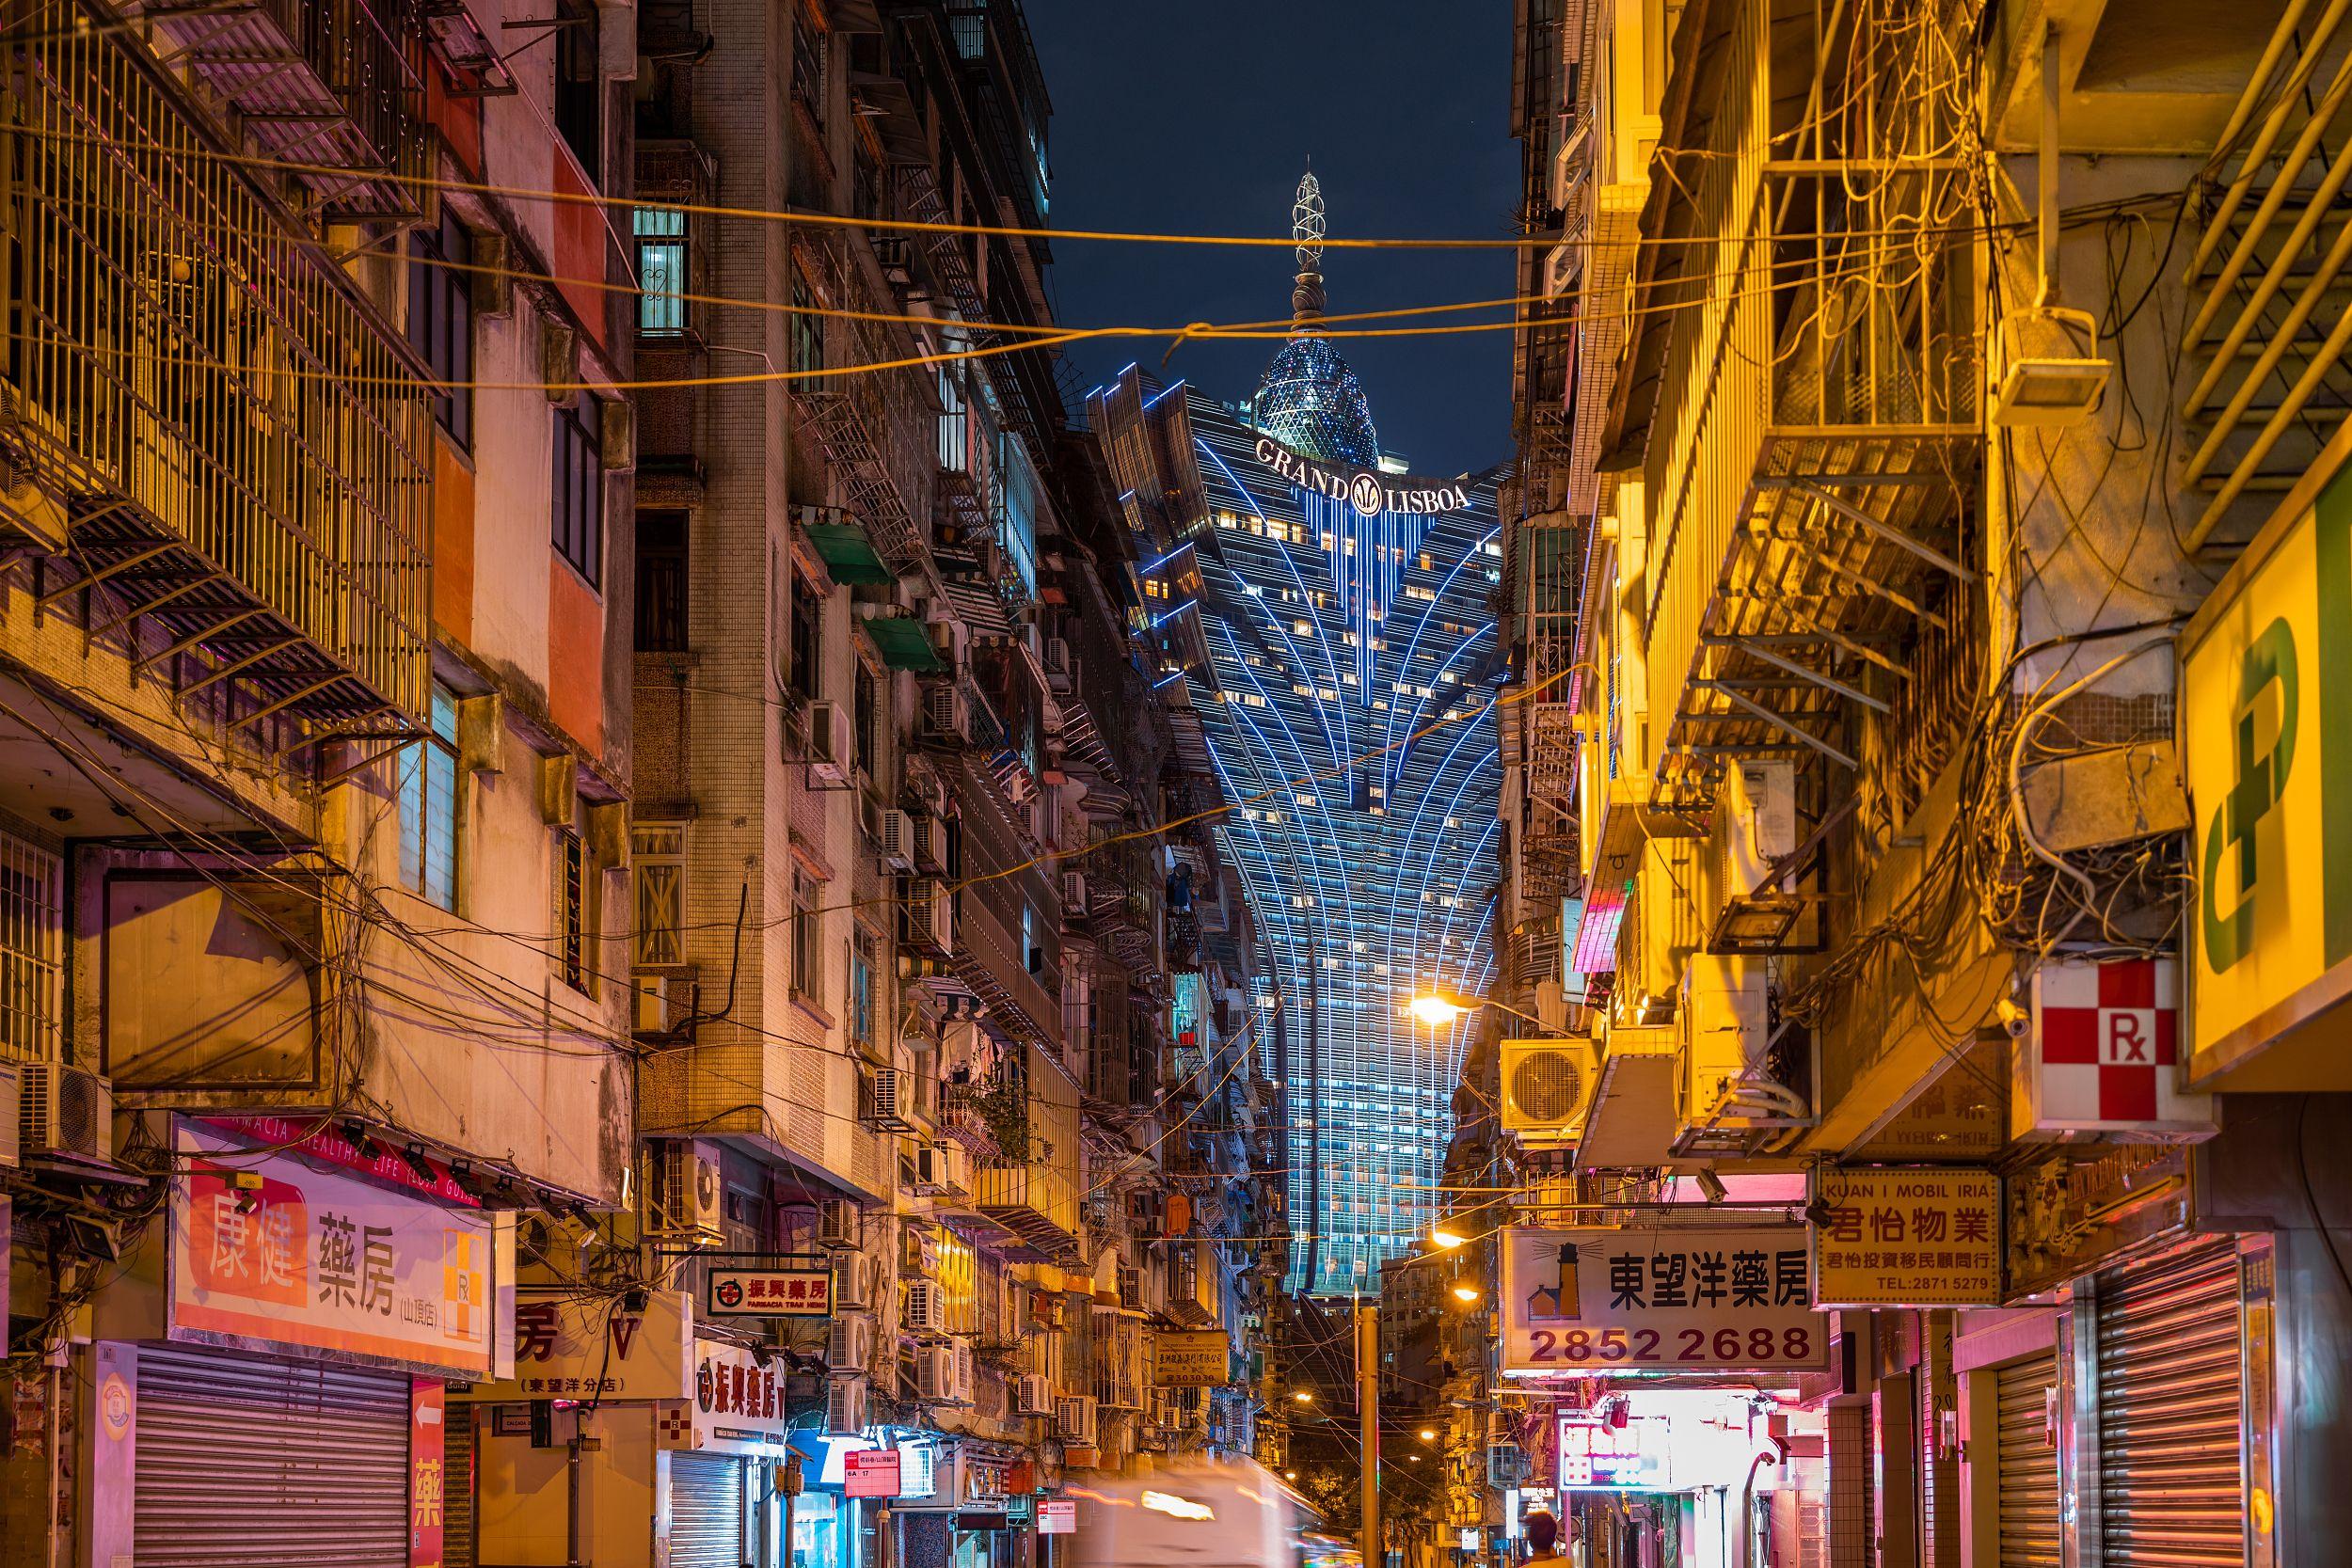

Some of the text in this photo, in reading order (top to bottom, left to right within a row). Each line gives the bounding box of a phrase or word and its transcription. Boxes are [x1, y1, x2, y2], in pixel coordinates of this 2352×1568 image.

[1255, 438, 1471, 515] GRAND LISBOA
[373, 1155, 399, 1178] LIFE
[1826, 1184, 1989, 1197] KUAN I MOBIL IRIA
[1827, 1207, 1989, 1243] 君怡物業
[1826, 1252, 1990, 1269] 君怡投資移民顧問行
[1609, 1249, 1807, 1311] 東望洋藥房
[1953, 1277, 1988, 1290] 5279
[1529, 1327, 1811, 1362] 2852 2688
